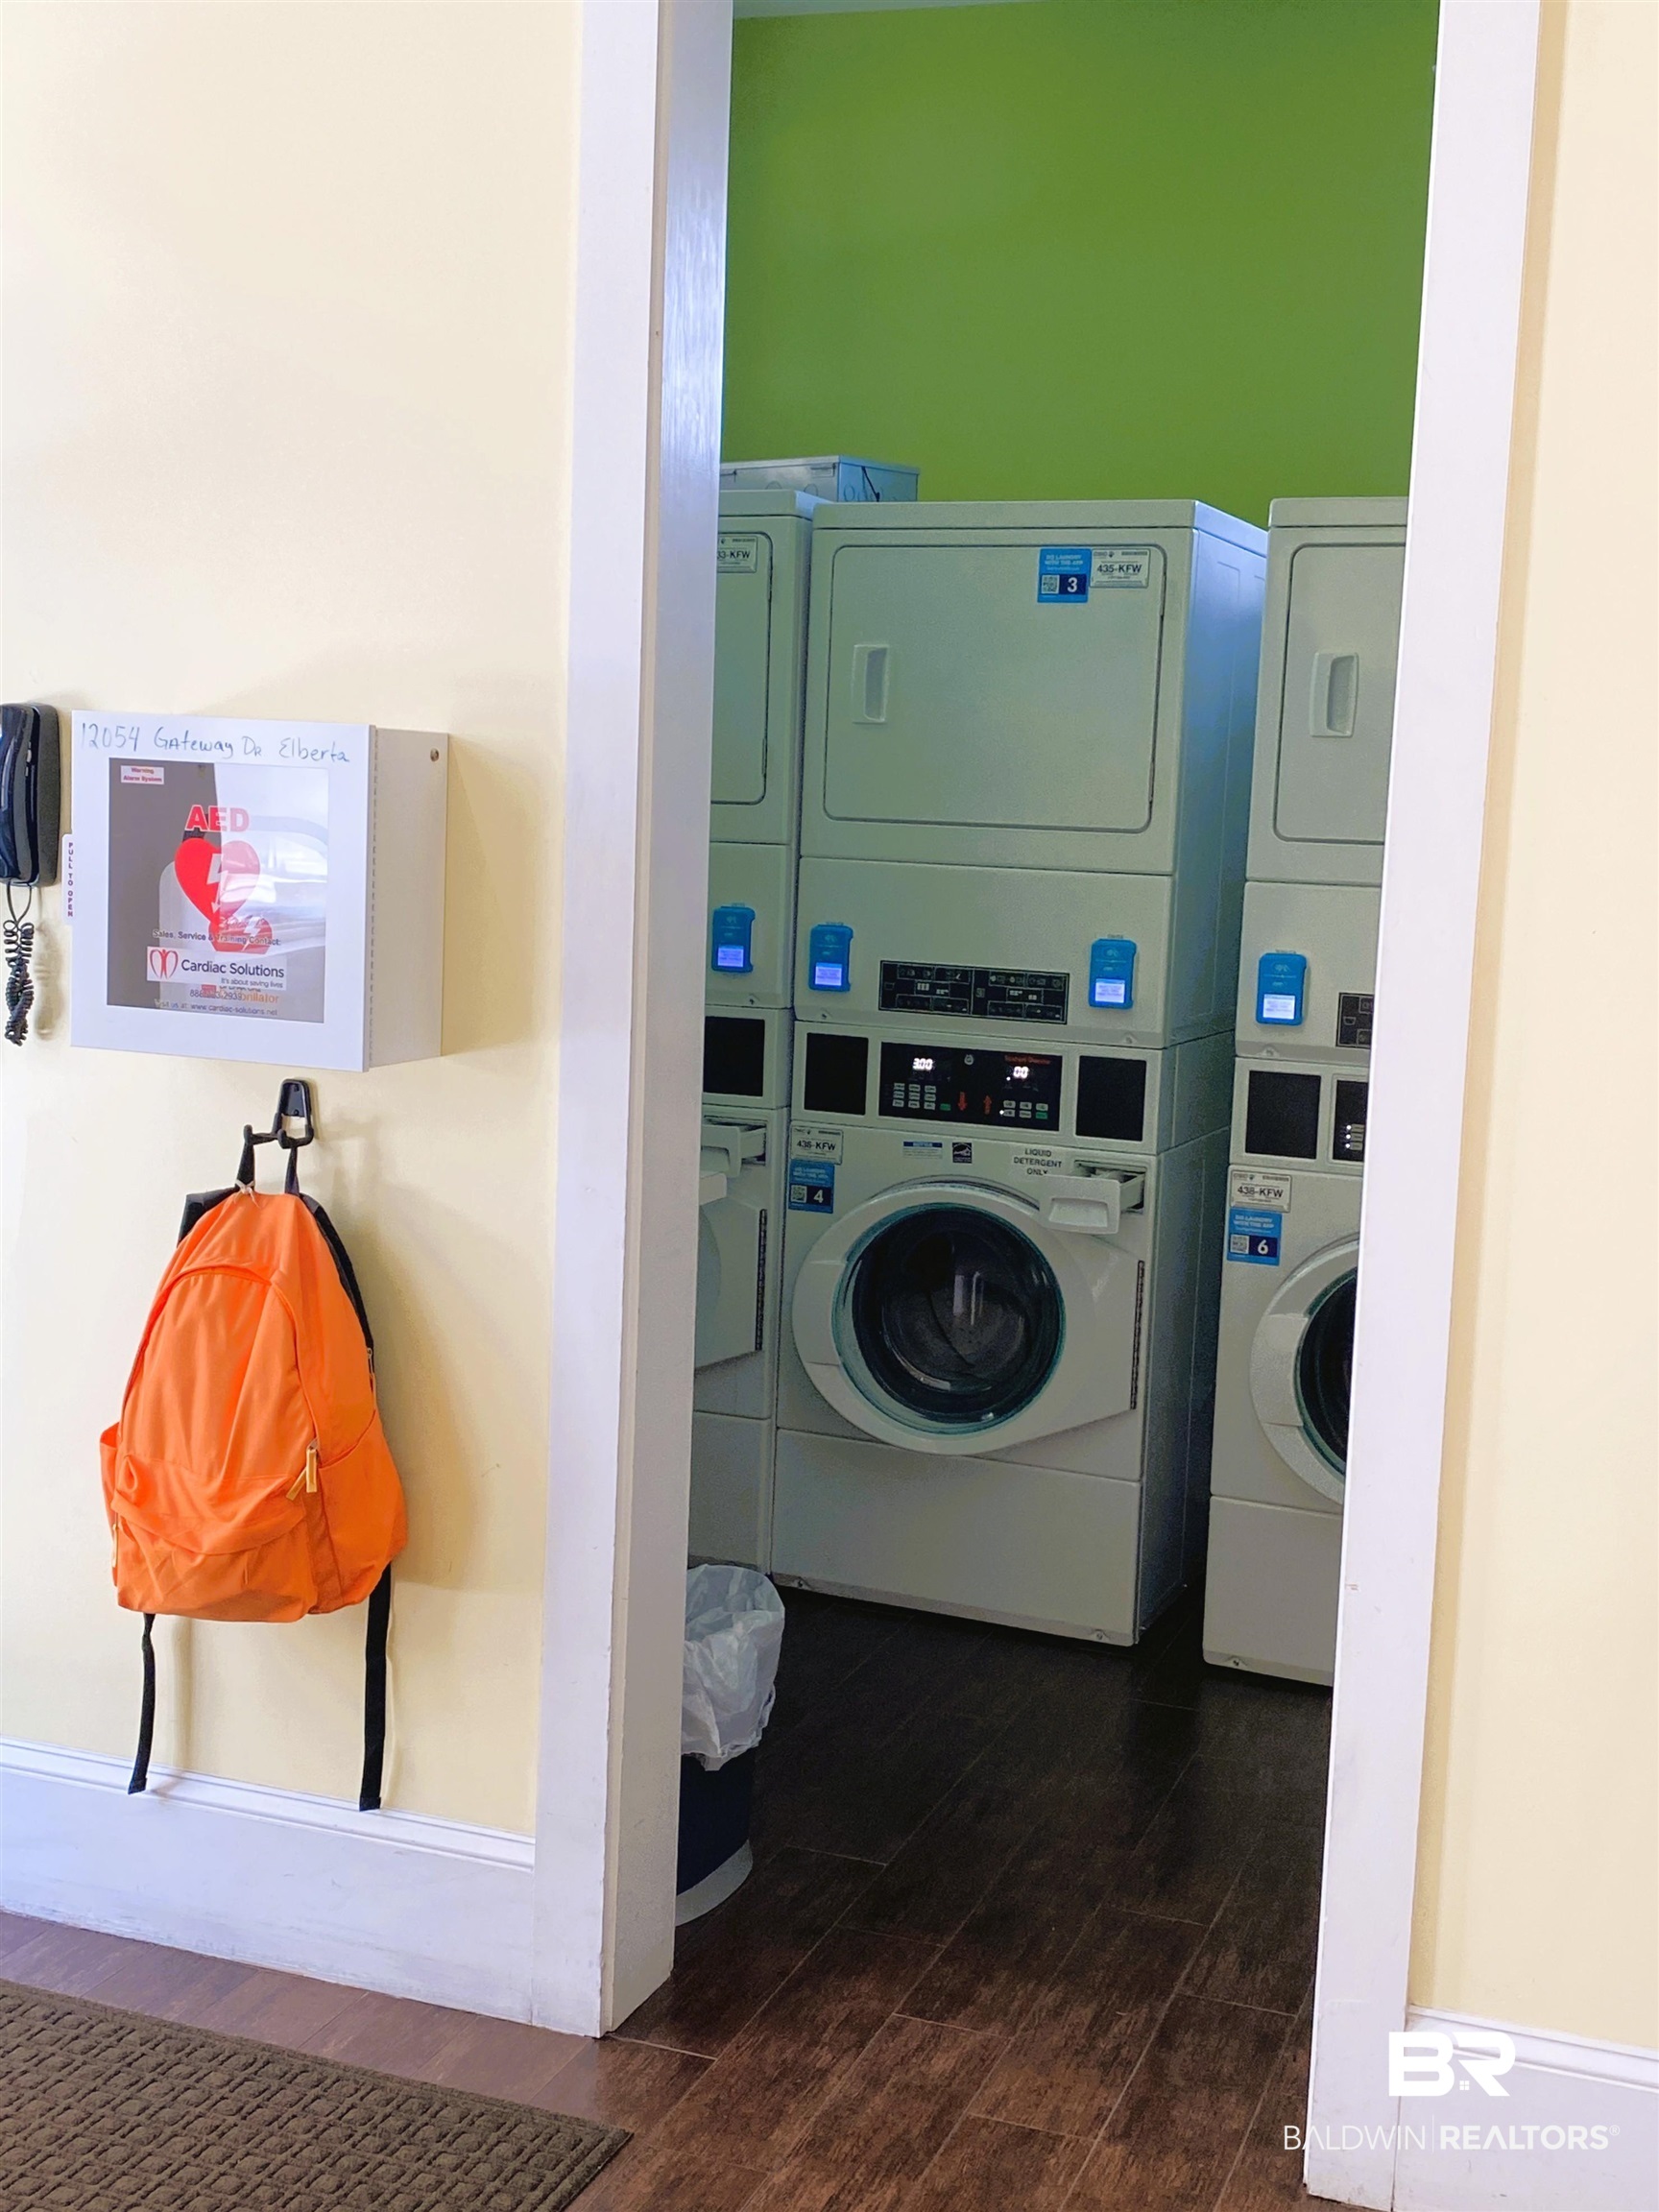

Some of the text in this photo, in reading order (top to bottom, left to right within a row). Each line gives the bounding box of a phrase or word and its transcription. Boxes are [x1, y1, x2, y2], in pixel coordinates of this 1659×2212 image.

[1097, 564, 1142, 573] 435-KFW
[1067, 577, 1077, 592] 3
[82, 722, 140, 752] 12054
[278, 736, 349, 762] Elberta
[185, 805, 250, 832] AED
[68, 873, 73, 886] TO
[178, 931, 206, 941] Service
[216, 934, 247, 945] Training
[181, 959, 285, 978] Cardiac Solutions
[250, 979, 269, 990] saving
[270, 980, 283, 989] lives
[1024, 1148, 1052, 1157] LIQUID
[1014, 1157, 1062, 1167] DETERGENT
[813, 1190, 824, 1203] 4
[1258, 1239, 1268, 1255] 6
